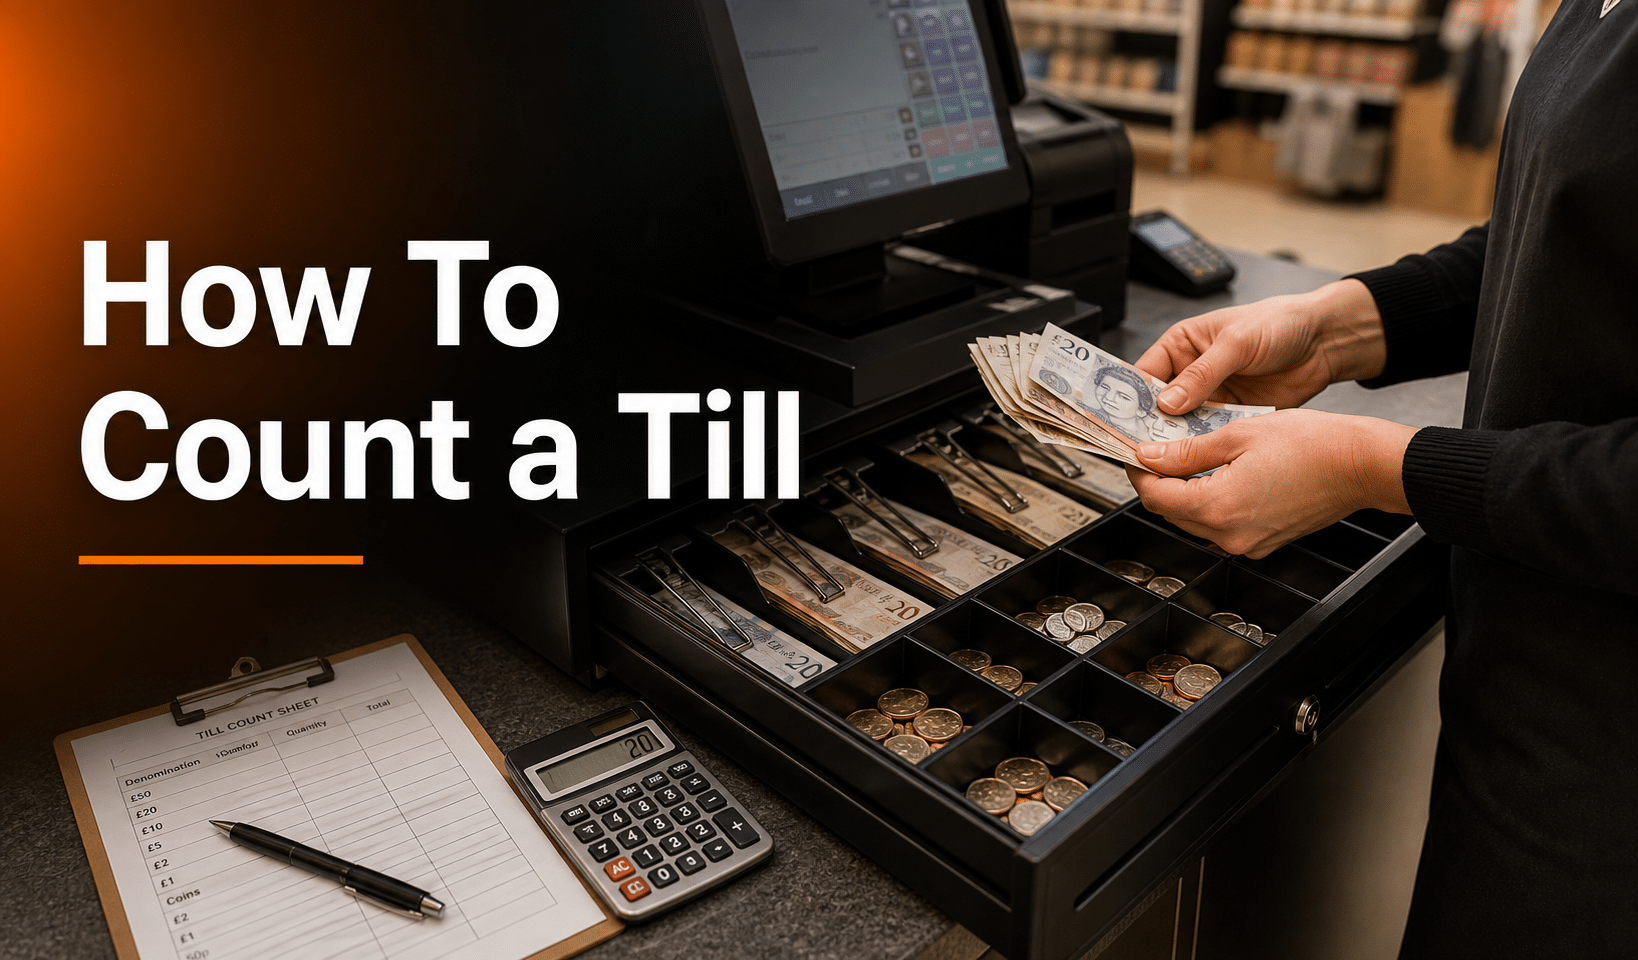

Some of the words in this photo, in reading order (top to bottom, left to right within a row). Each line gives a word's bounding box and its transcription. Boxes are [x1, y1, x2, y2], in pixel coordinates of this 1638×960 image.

[885, 600, 920, 620] 20
[785, 655, 823, 679] 20
[366, 699, 391, 711] Total
[196, 726, 225, 740] TILL
[227, 710, 274, 732] COUNT
[277, 696, 319, 716] SHEET
[624, 734, 654, 759] 20
[130, 790, 152, 803] £50
[136, 806, 157, 819] £20
[142, 822, 163, 835] £10
[148, 841, 162, 852] £5
[642, 849, 653, 860] 1
[154, 858, 170, 870] £2
[612, 860, 630, 875] AC
[657, 867, 670, 880] 0
[161, 876, 174, 888] £1
[166, 888, 201, 905] Coins
[173, 912, 189, 925] £2
[180, 931, 195, 944] £1
